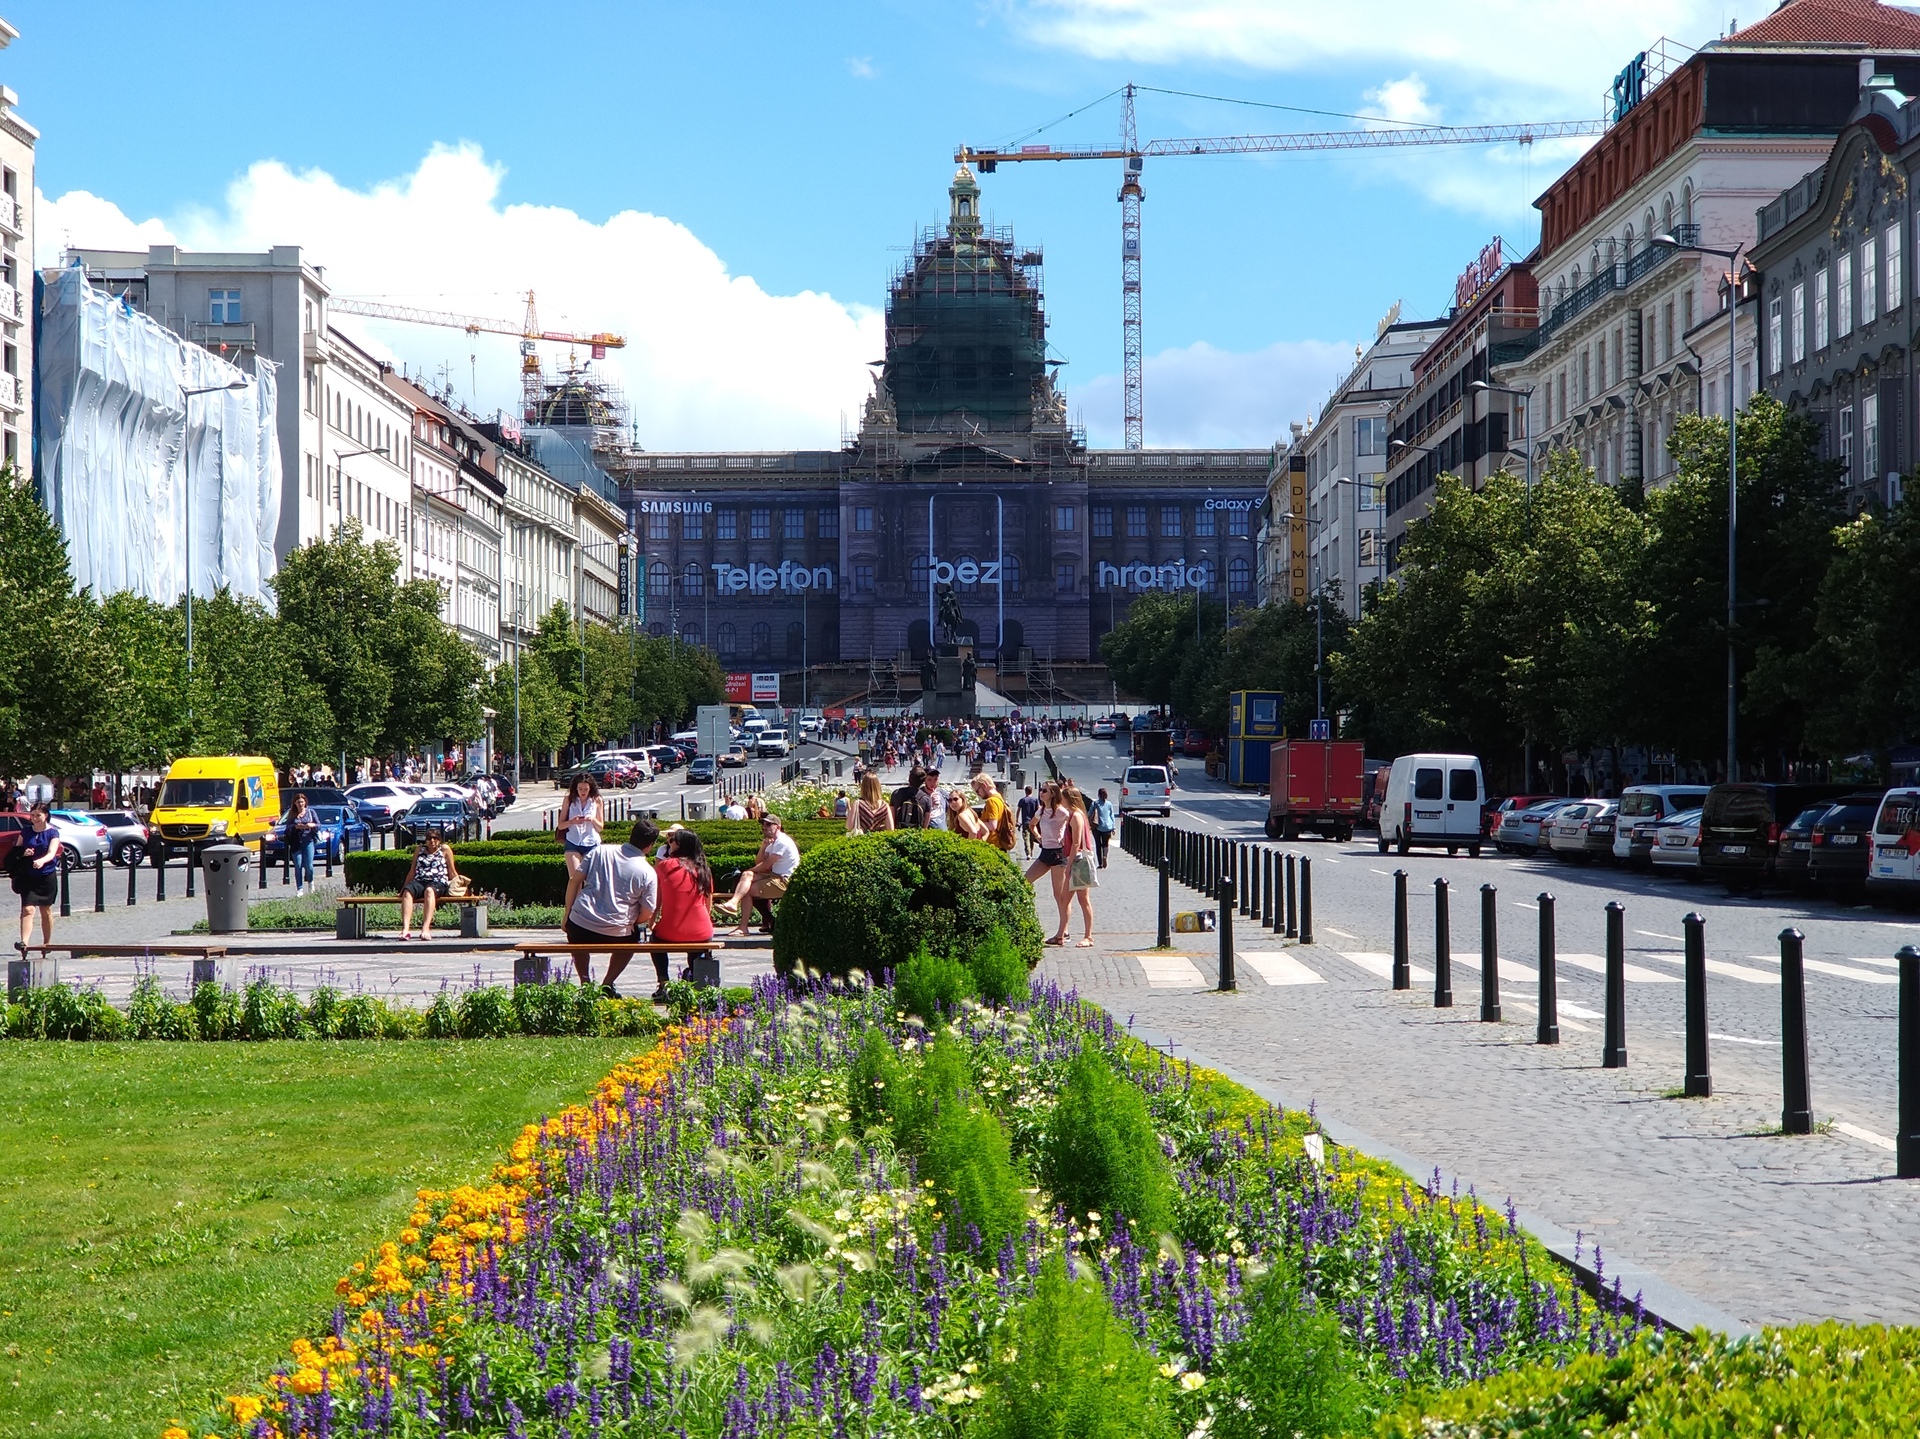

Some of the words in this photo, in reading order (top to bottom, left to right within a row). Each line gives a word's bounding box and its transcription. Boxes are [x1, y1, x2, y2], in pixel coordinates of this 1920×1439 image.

[1612, 51, 1646, 123] SZIF
[641, 501, 713, 513] SAMSUNG
[1204, 498, 1253, 511] Galaxy
[620, 557, 628, 614] McDonald's
[711, 560, 833, 591] Telefon
[932, 557, 1001, 584] bez
[1099, 558, 1207, 588] hranic
